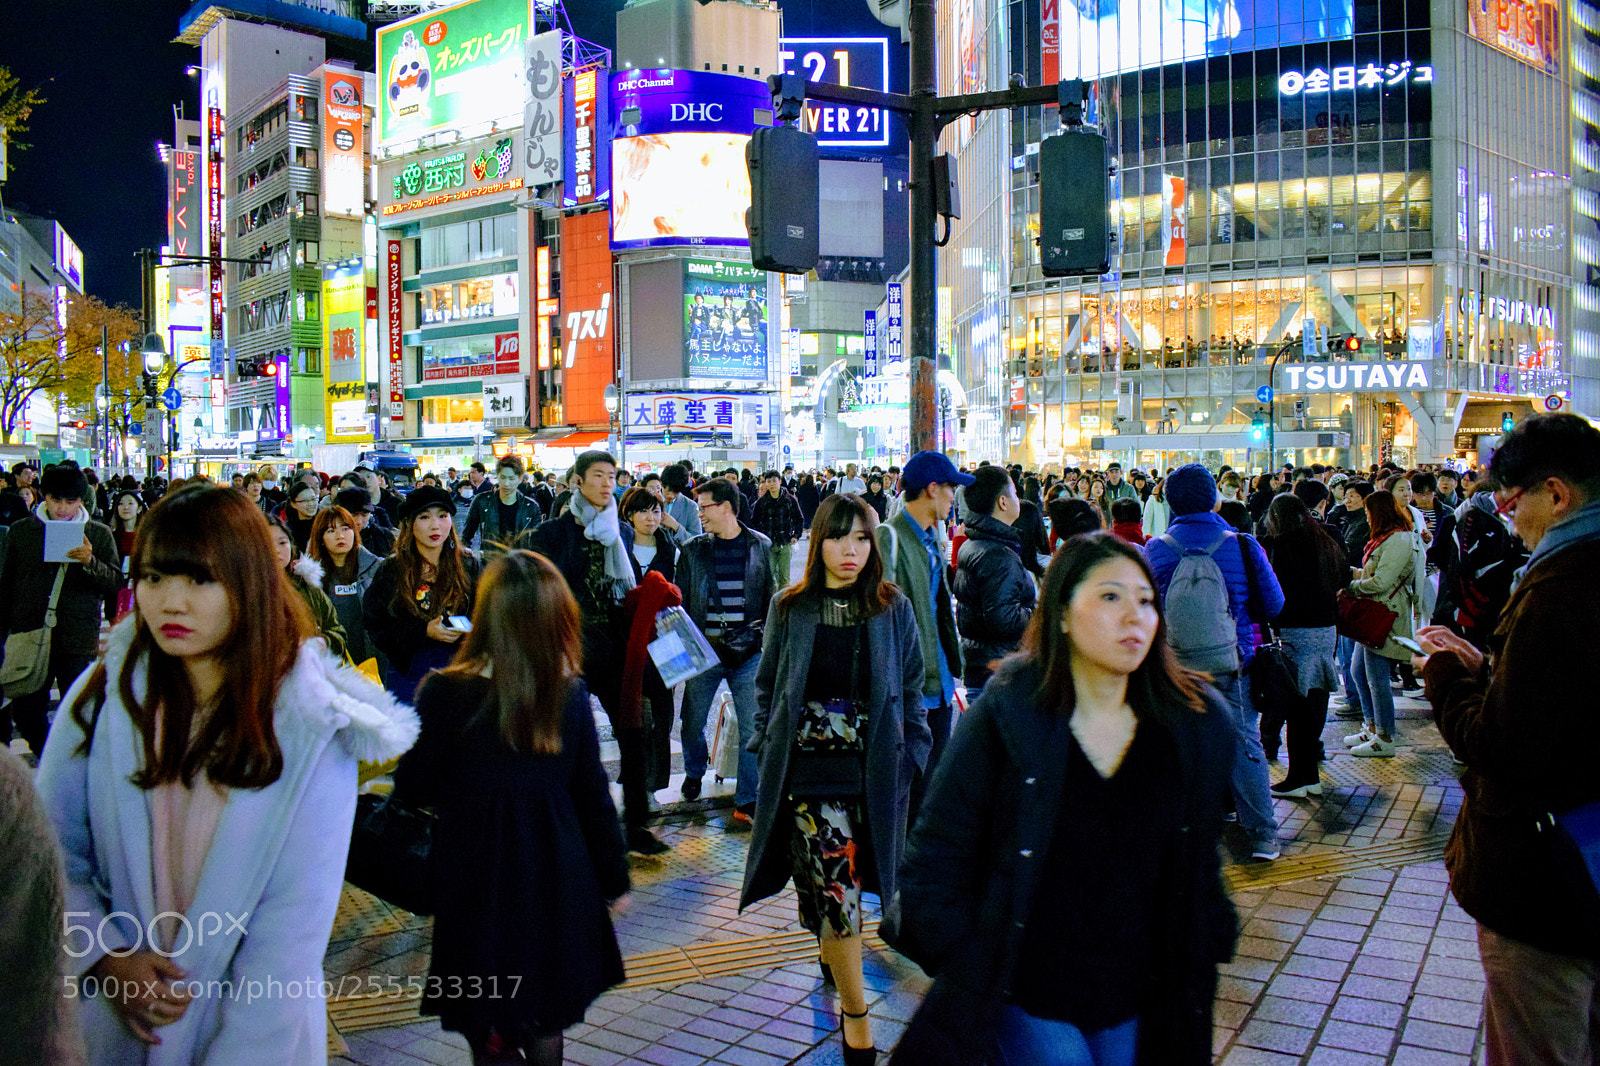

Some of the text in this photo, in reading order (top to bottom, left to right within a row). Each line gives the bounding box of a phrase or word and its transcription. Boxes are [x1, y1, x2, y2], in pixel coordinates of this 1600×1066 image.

[1498, 0, 1536, 46] BTS
[435, 23, 522, 72] オッズパーク!
[618, 77, 674, 91] DHC Channel
[526, 50, 560, 179] もんじゃ
[670, 103, 723, 122] DHC
[856, 108, 879, 132] 21
[187, 152, 195, 186] TOKYO
[424, 163, 465, 193] 西村
[688, 263, 714, 275] DMM
[391, 262, 400, 352] ウィンターフルーツギフト
[889, 287, 901, 357] 洋服の青山
[333, 327, 355, 361] 薬
[498, 337, 518, 357] JTB
[565, 292, 611, 369] クスリ
[866, 318, 876, 378] 洋服の青
[1285, 363, 1429, 390] TSUTAYA
